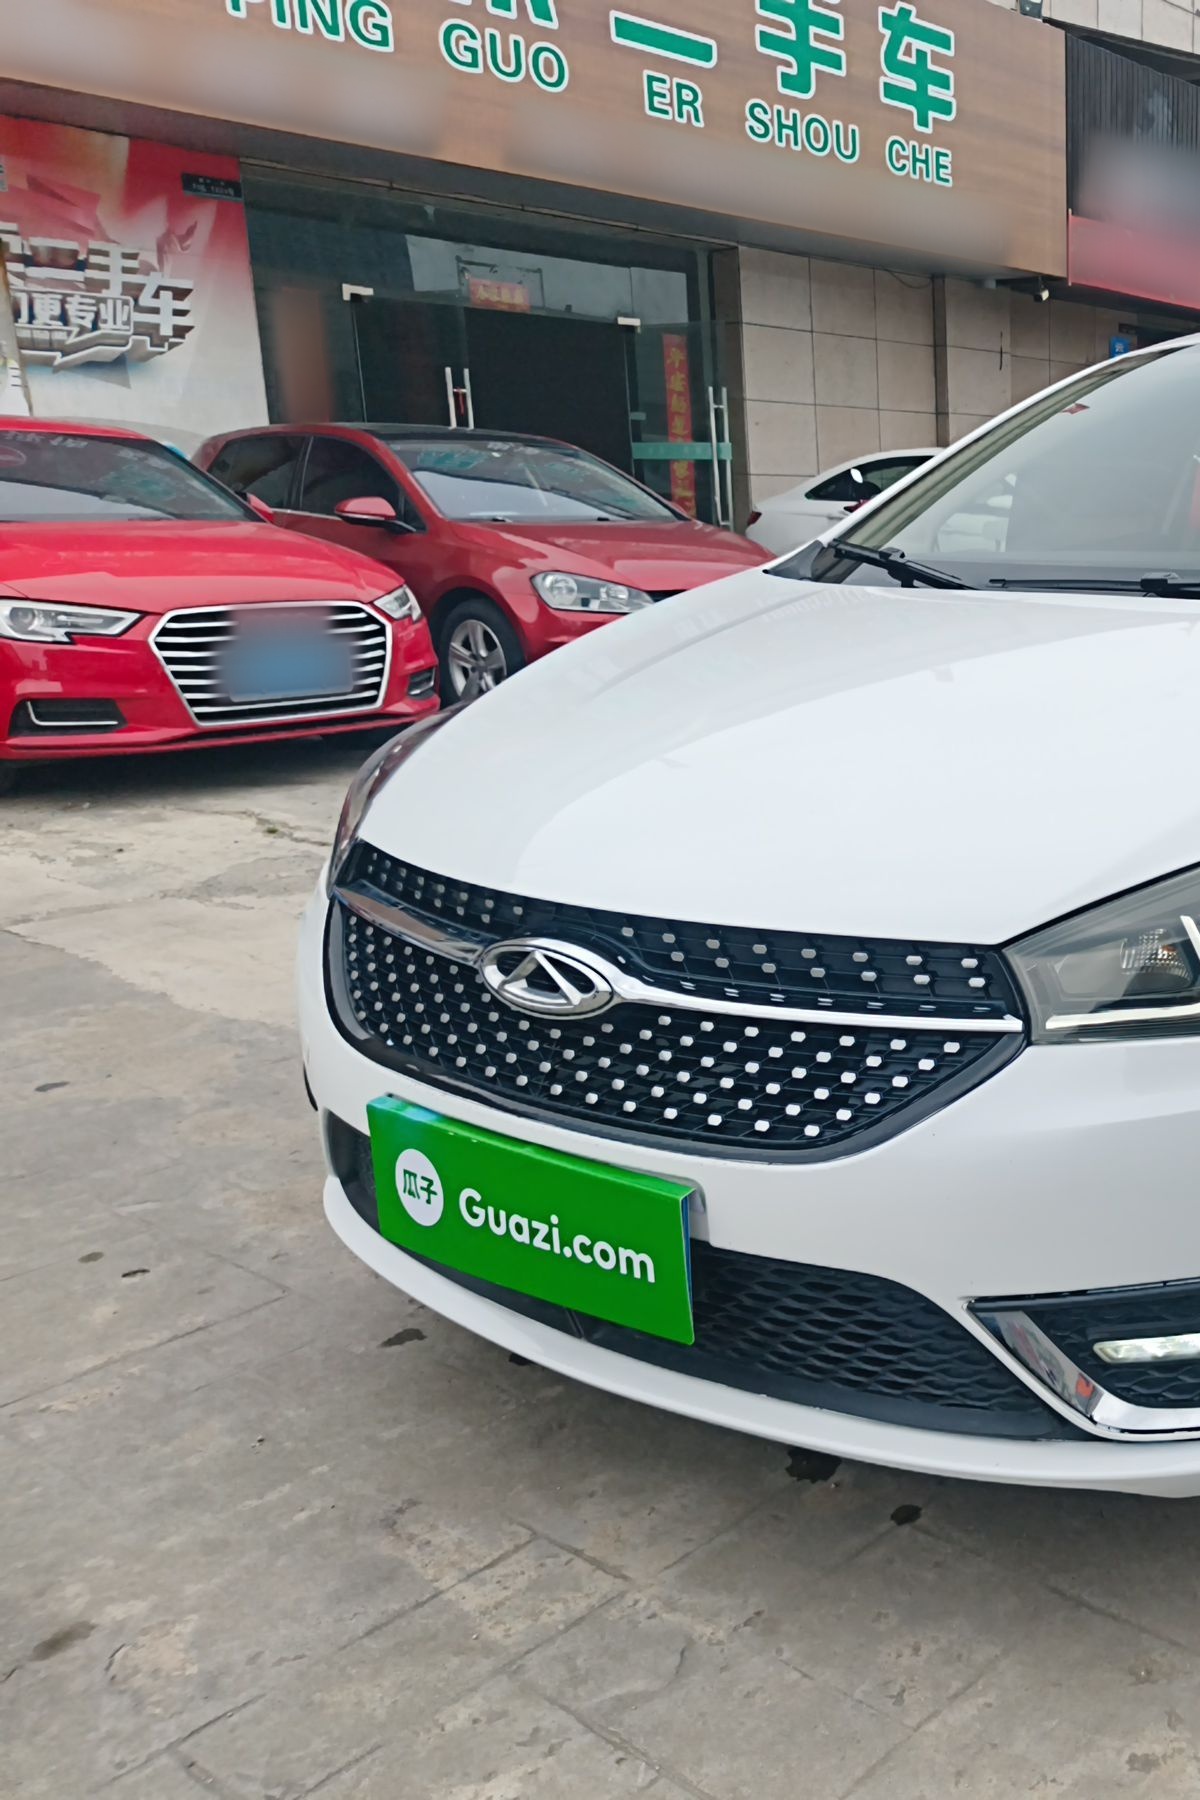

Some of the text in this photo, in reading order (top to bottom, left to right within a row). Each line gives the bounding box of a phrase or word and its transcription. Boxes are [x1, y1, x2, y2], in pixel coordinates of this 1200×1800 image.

[439, 18, 569, 93] GUO
[643, 69, 704, 127] ER
[745, 98, 860, 164] SHOU
[885, 135, 953, 187] CHE
[403, 1168, 438, 1205] 瓜子
[459, 1187, 656, 1284] Guazi.com
